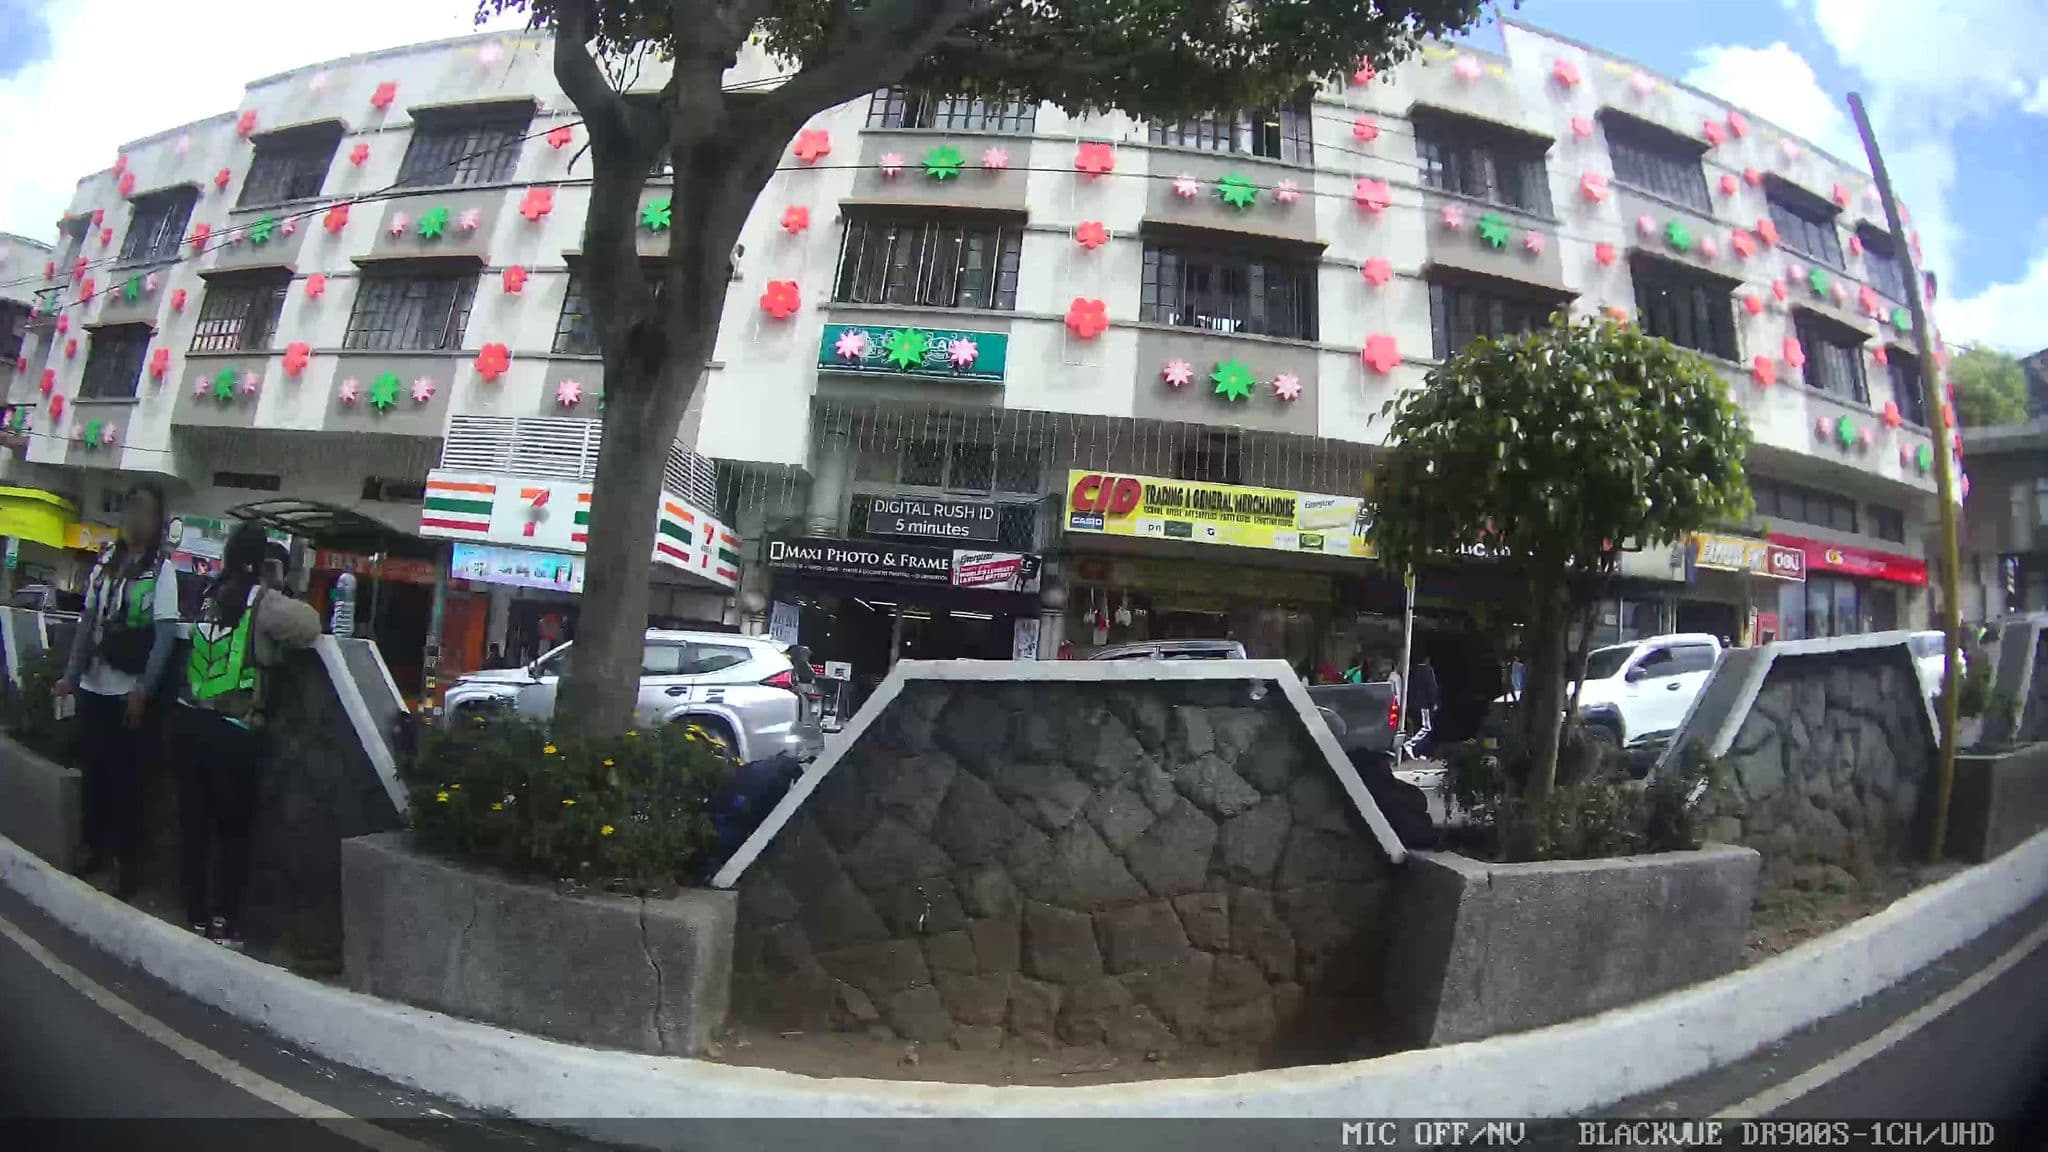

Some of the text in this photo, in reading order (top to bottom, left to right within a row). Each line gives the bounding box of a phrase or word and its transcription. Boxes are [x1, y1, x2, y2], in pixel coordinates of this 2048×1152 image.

[874, 500, 994, 520] DIGITAL RUSH ID
[1145, 484, 1184, 507] TRADING
[1193, 489, 1233, 513] GENERAL
[1234, 494, 1296, 519] MERCHANDISE
[895, 519, 970, 537] 5 minutes
[1071, 516, 1103, 526] CASIO
[785, 545, 822, 560] MAXI
[827, 548, 880, 565] PHOTO
[883, 552, 896, 566] &
[900, 554, 949, 570] FRAME
